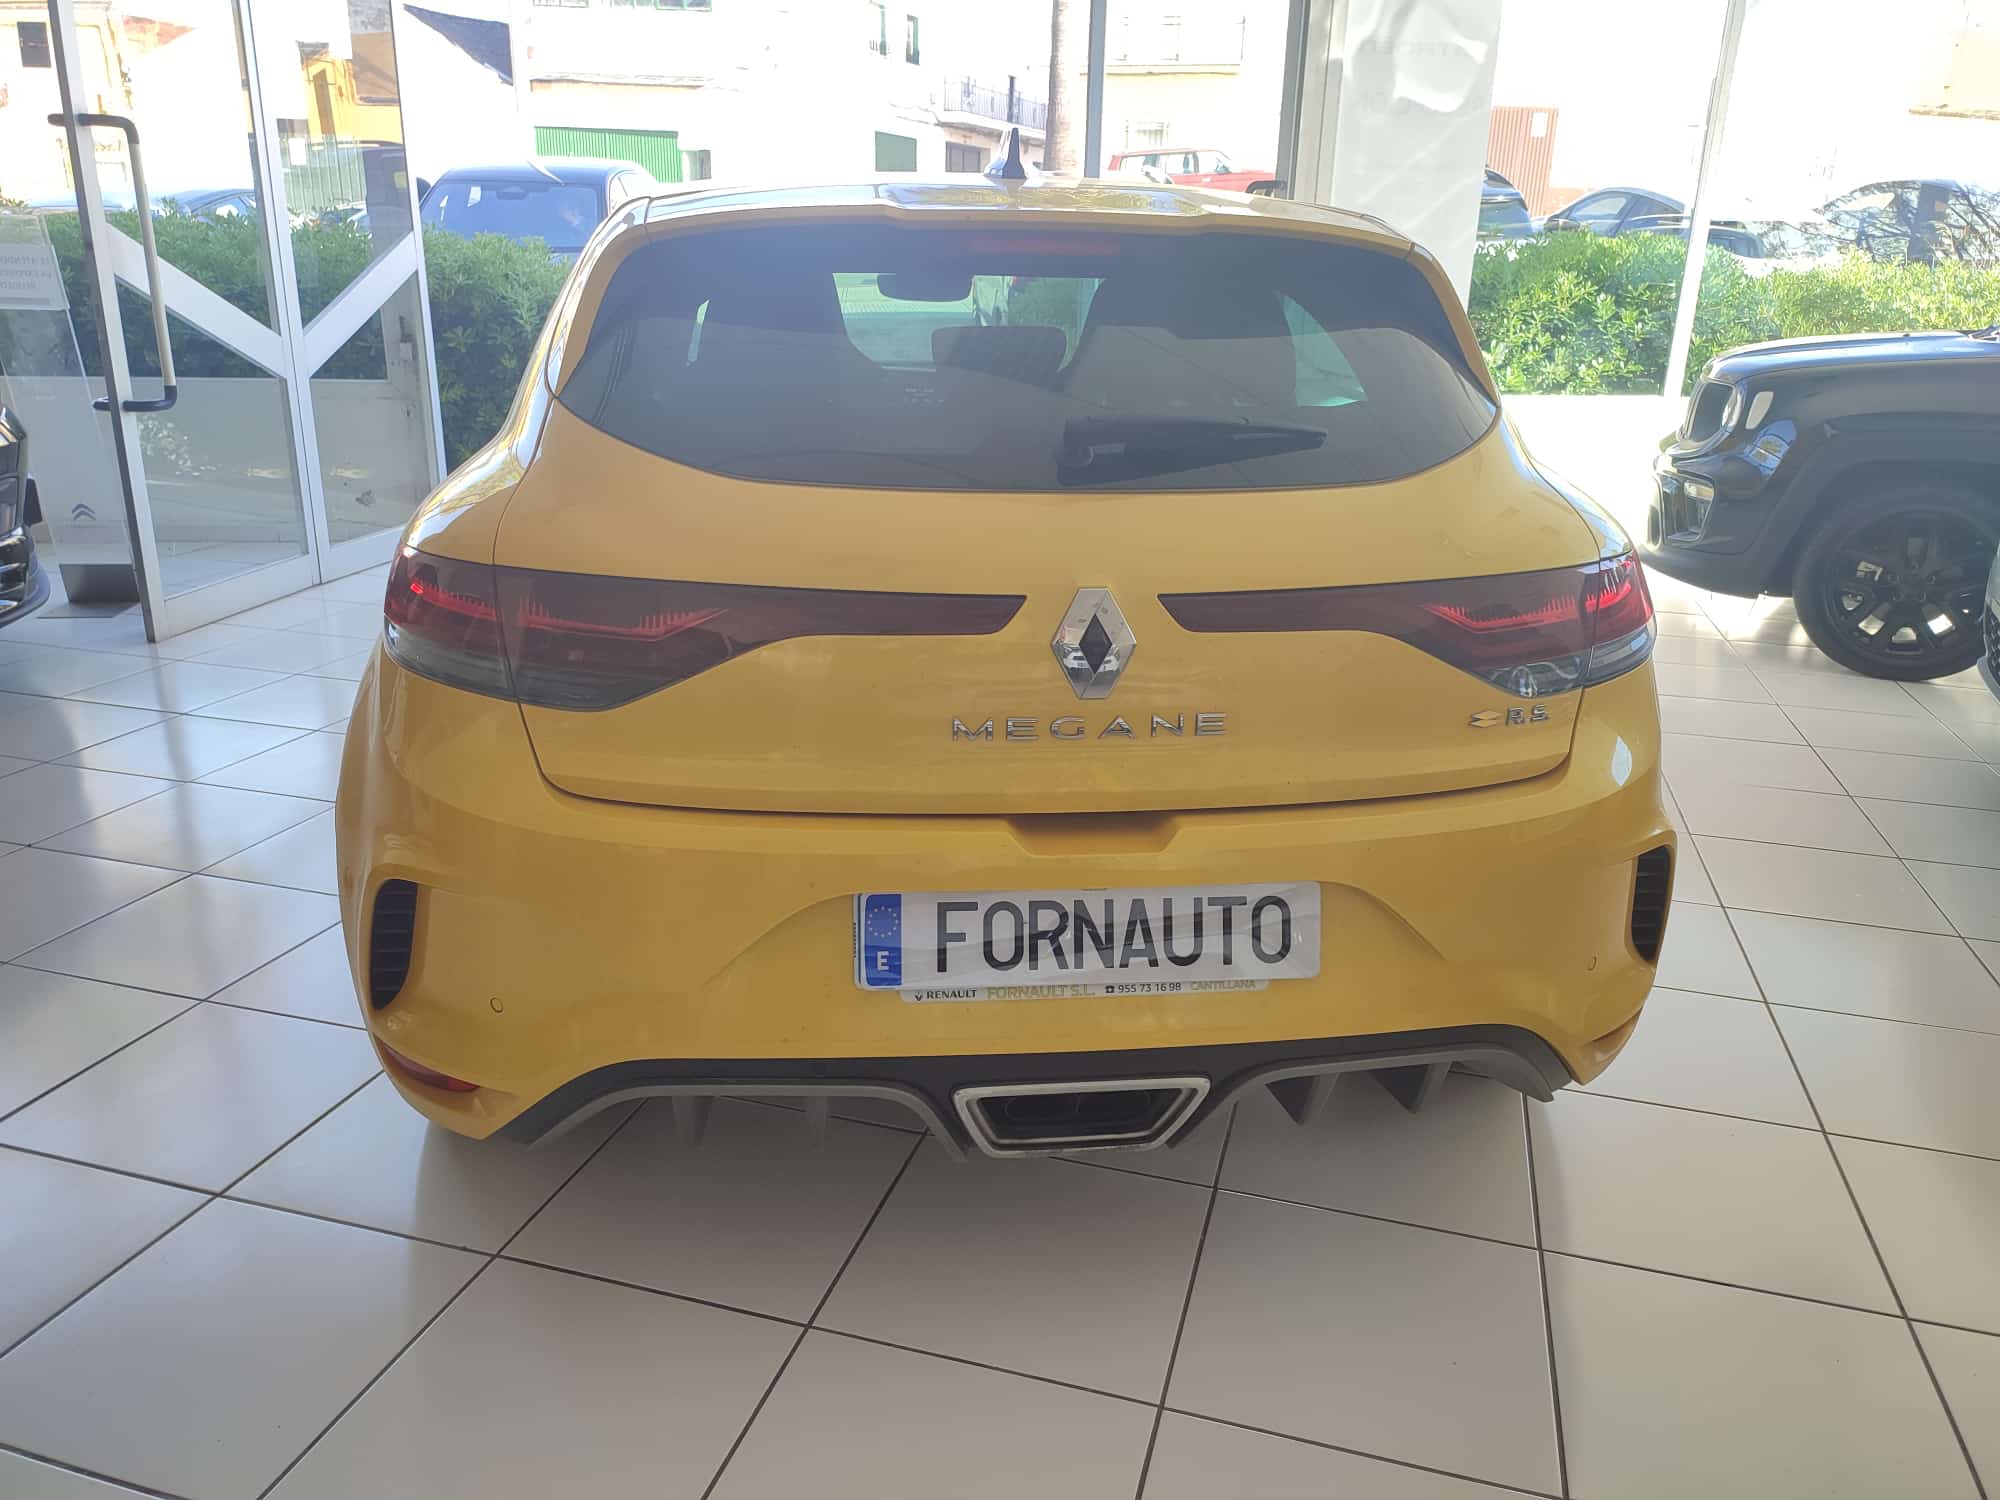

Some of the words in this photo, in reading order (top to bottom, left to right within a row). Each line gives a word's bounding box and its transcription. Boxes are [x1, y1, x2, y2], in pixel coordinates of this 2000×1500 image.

[952, 712, 1228, 741] MEGANE
[936, 895, 1293, 973] FORNAUTO
[877, 951, 889, 970] E
[926, 989, 977, 1000] RENAULT
[1118, 984, 1137, 994] 955
[1139, 983, 1152, 993] 73
[1155, 983, 1167, 993] 16
[1168, 982, 1182, 992] 98
